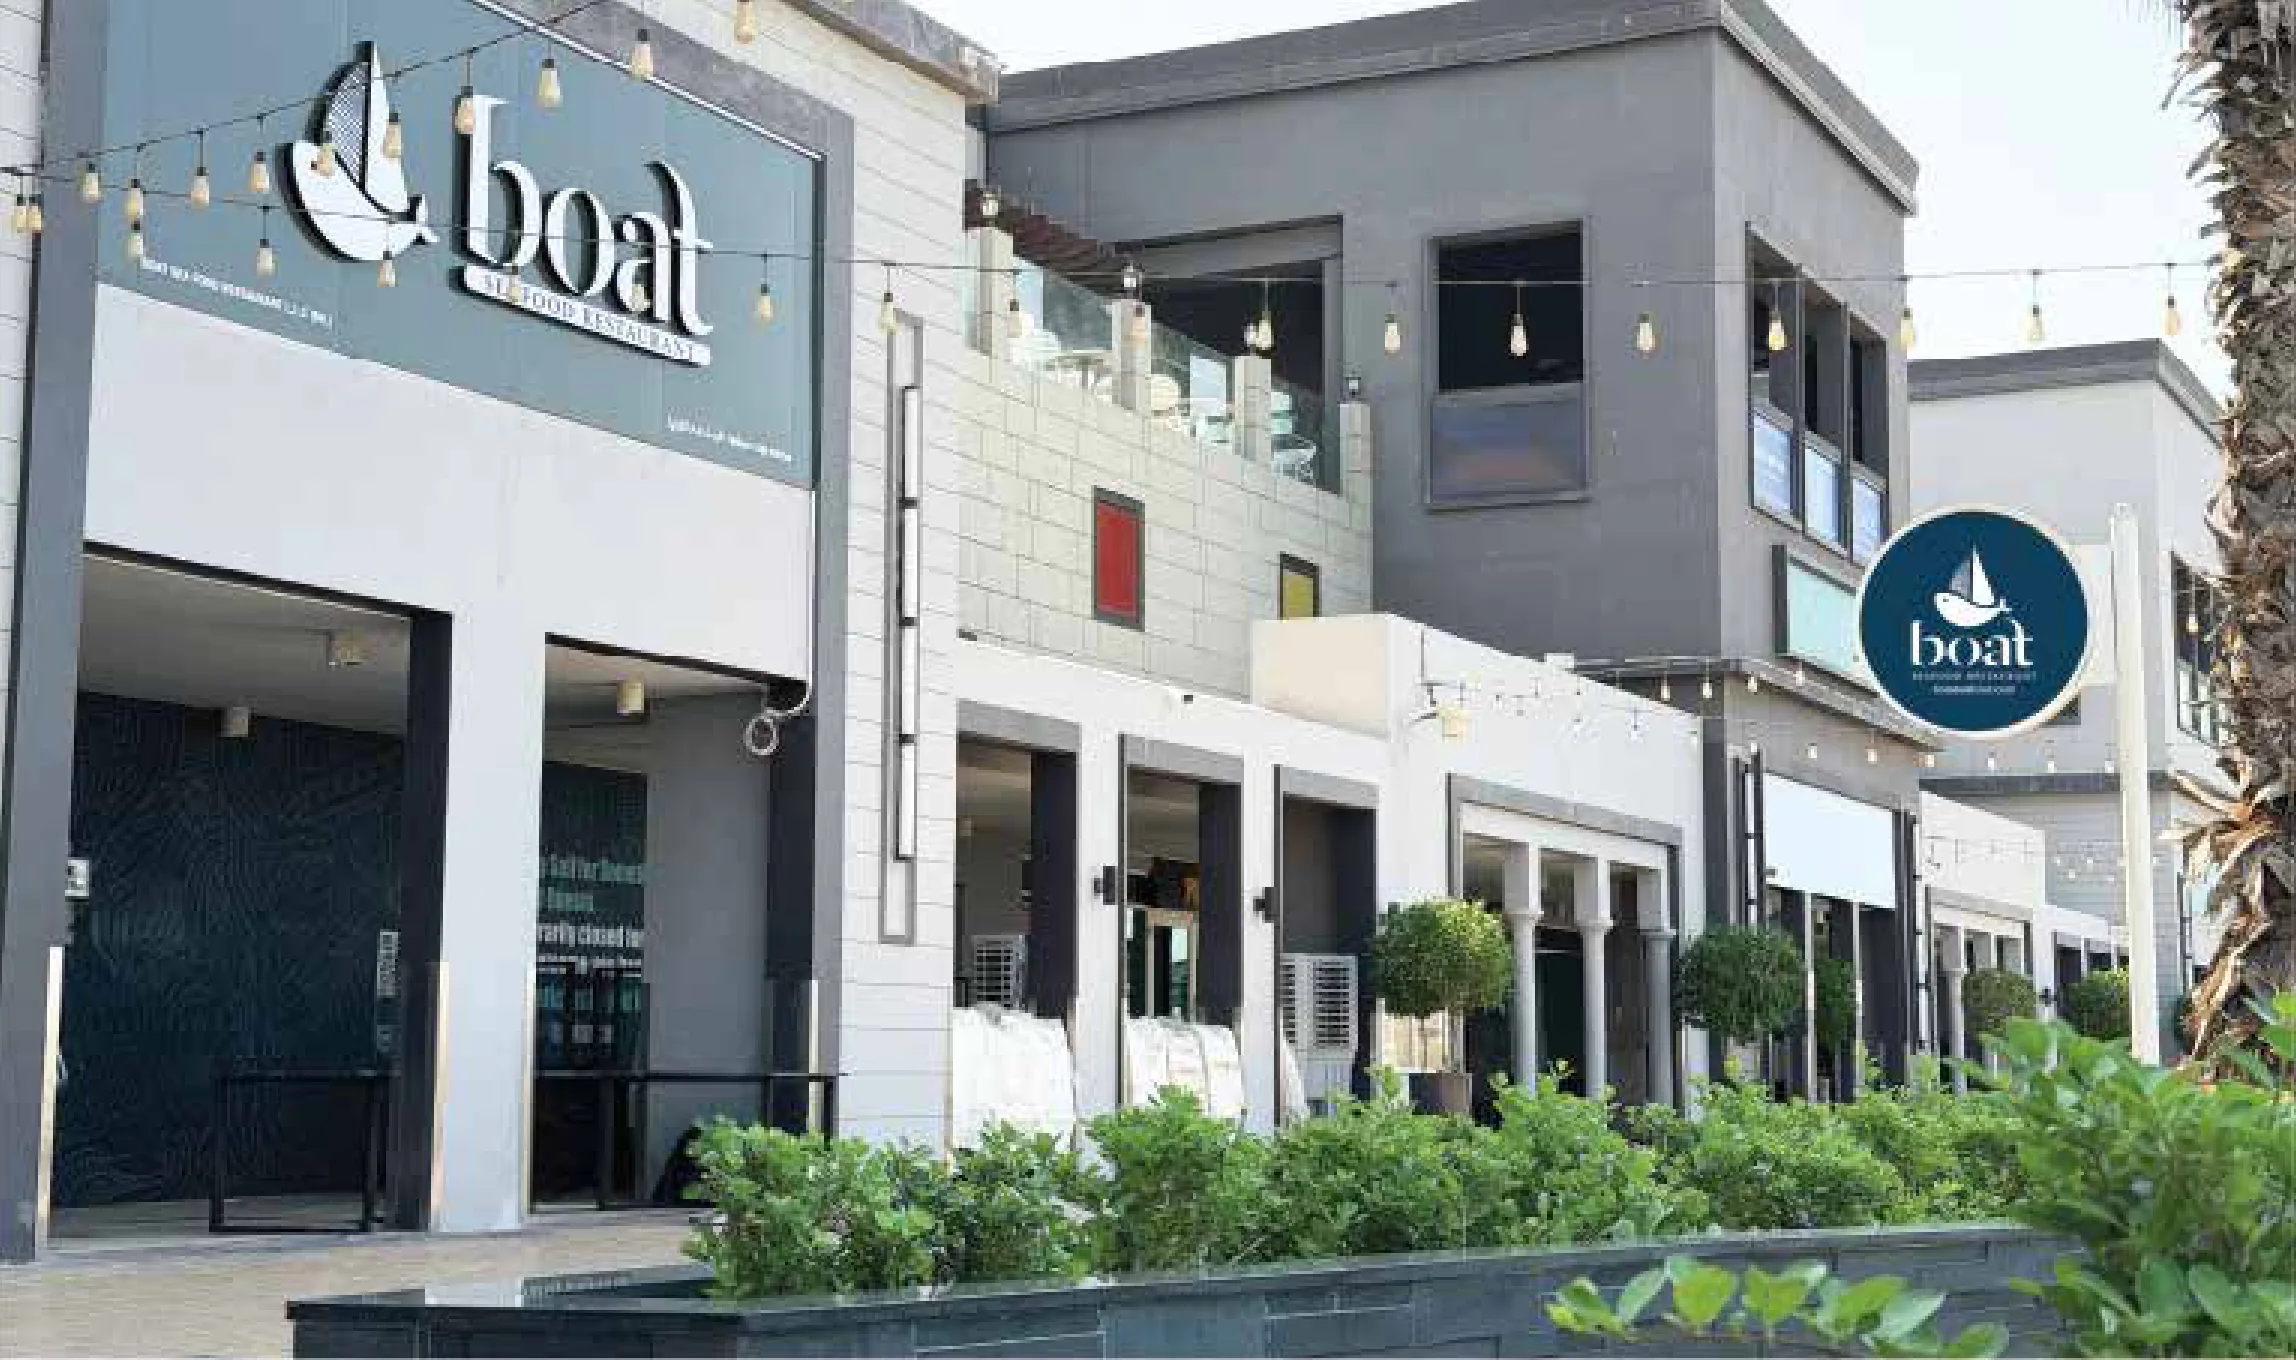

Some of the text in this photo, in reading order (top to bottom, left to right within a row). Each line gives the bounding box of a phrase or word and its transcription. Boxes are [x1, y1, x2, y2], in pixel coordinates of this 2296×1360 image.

[466, 94, 713, 337] boat
[484, 274, 694, 360] SEFOOD RESTAURANT
[1910, 618, 2034, 667] boat
[537, 921, 576, 948] rarily
